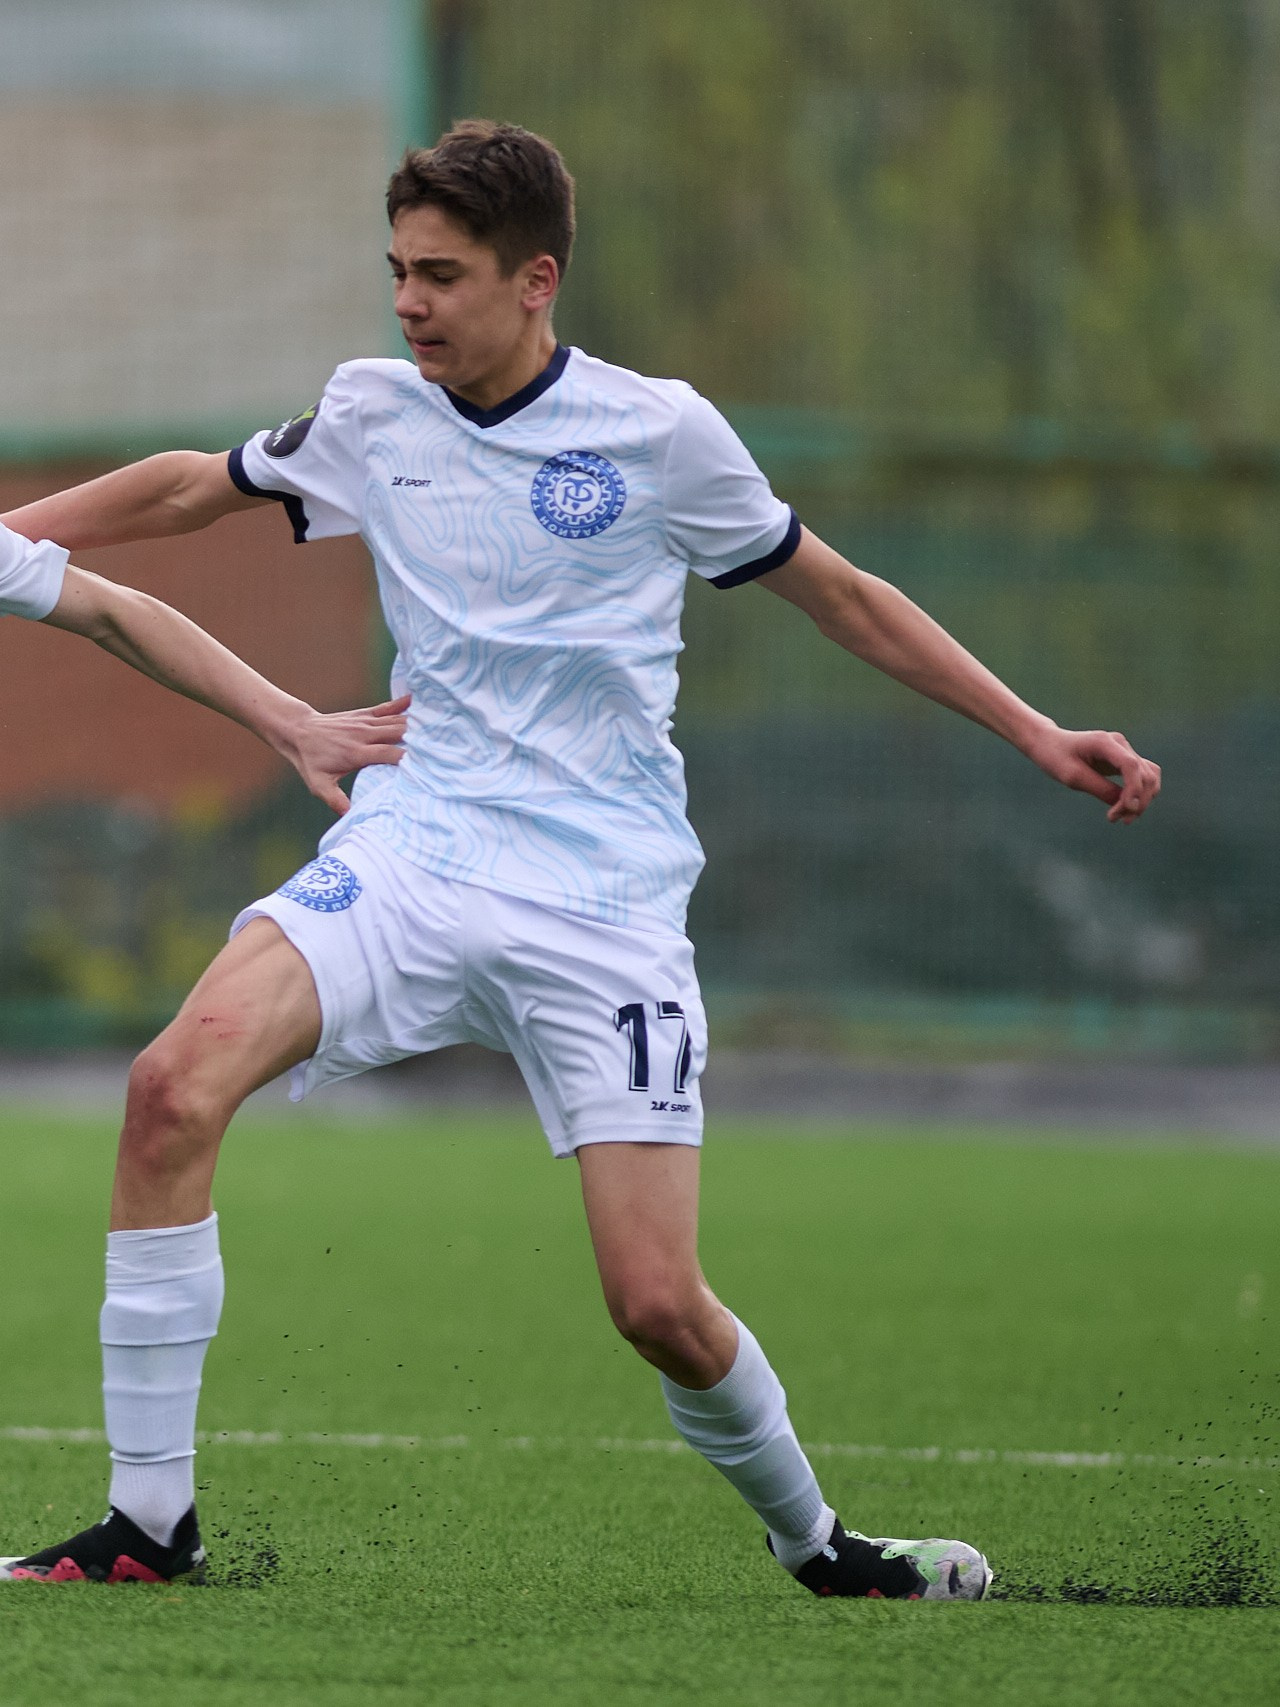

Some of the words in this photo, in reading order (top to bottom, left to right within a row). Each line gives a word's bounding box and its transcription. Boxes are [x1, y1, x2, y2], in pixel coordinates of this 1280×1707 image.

[404, 478, 432, 488] SPORT
[531, 453, 580, 511] ТРУДОЫЕ
[587, 454, 625, 516] РЕЗЕРВЫ
[540, 518, 611, 538] СТАДИОН
[613, 1001, 691, 1094] 17
